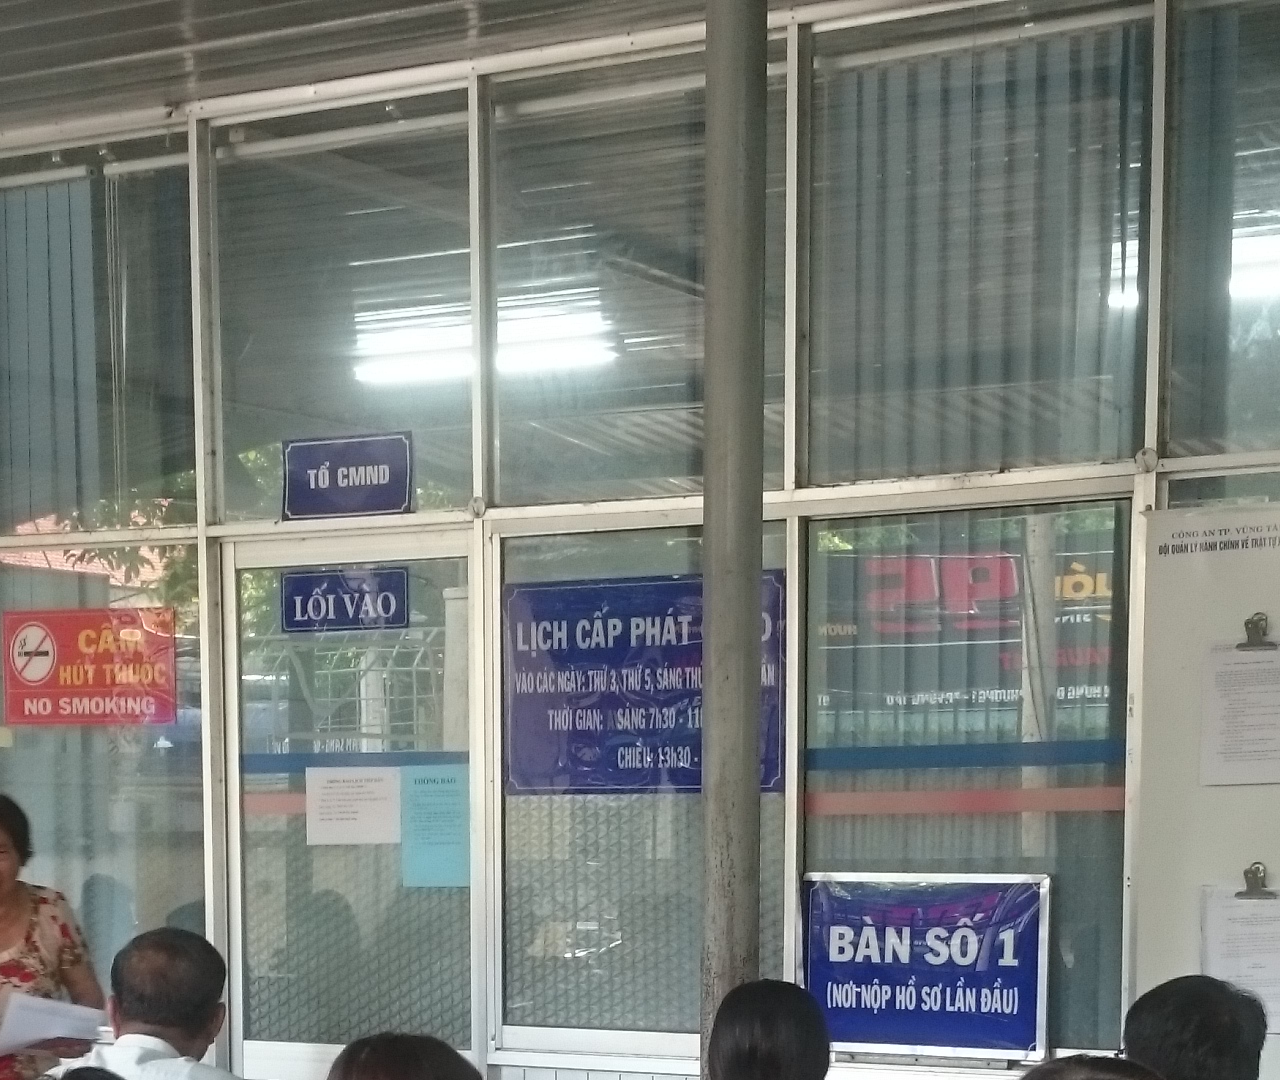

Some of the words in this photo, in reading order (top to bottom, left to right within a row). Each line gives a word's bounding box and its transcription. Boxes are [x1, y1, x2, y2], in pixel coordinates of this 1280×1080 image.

[307, 461, 329, 489] TỔ
[337, 465, 390, 488] CMND
[1172, 530, 1199, 539] CÔNG
[1202, 529, 1215, 537] AN
[293, 582, 336, 621] LỐI
[342, 583, 396, 618] VÀO
[516, 619, 568, 657] LỊCH
[576, 600, 622, 650] CẤP
[630, 607, 692, 647] PHÁT
[59, 659, 96, 685] HÚT
[515, 667, 534, 693] VÀO
[536, 667, 555, 693] CÁC
[610, 669, 619, 695] 3,
[645, 668, 654, 694] 5,
[657, 662, 682, 690] SÁNG
[24, 698, 51, 715] NO
[59, 696, 155, 715] SMOKING
[548, 704, 572, 730] THỜI
[576, 708, 603, 732] GIAN:
[617, 702, 645, 729] SÁNG
[649, 707, 676, 729] 7h30
[658, 746, 691, 768] 13h30
[829, 916, 911, 964] BÀN
[923, 913, 984, 966] SỐ
[998, 928, 1019, 967] 1
[827, 980, 857, 1009] (NƠI
[861, 978, 891, 1014] NỘP
[895, 975, 917, 1010] HỒ
[921, 983, 943, 1011] SƠ
[945, 976, 976, 1013] LẦN
[980, 977, 1019, 1015] ĐẦU)
